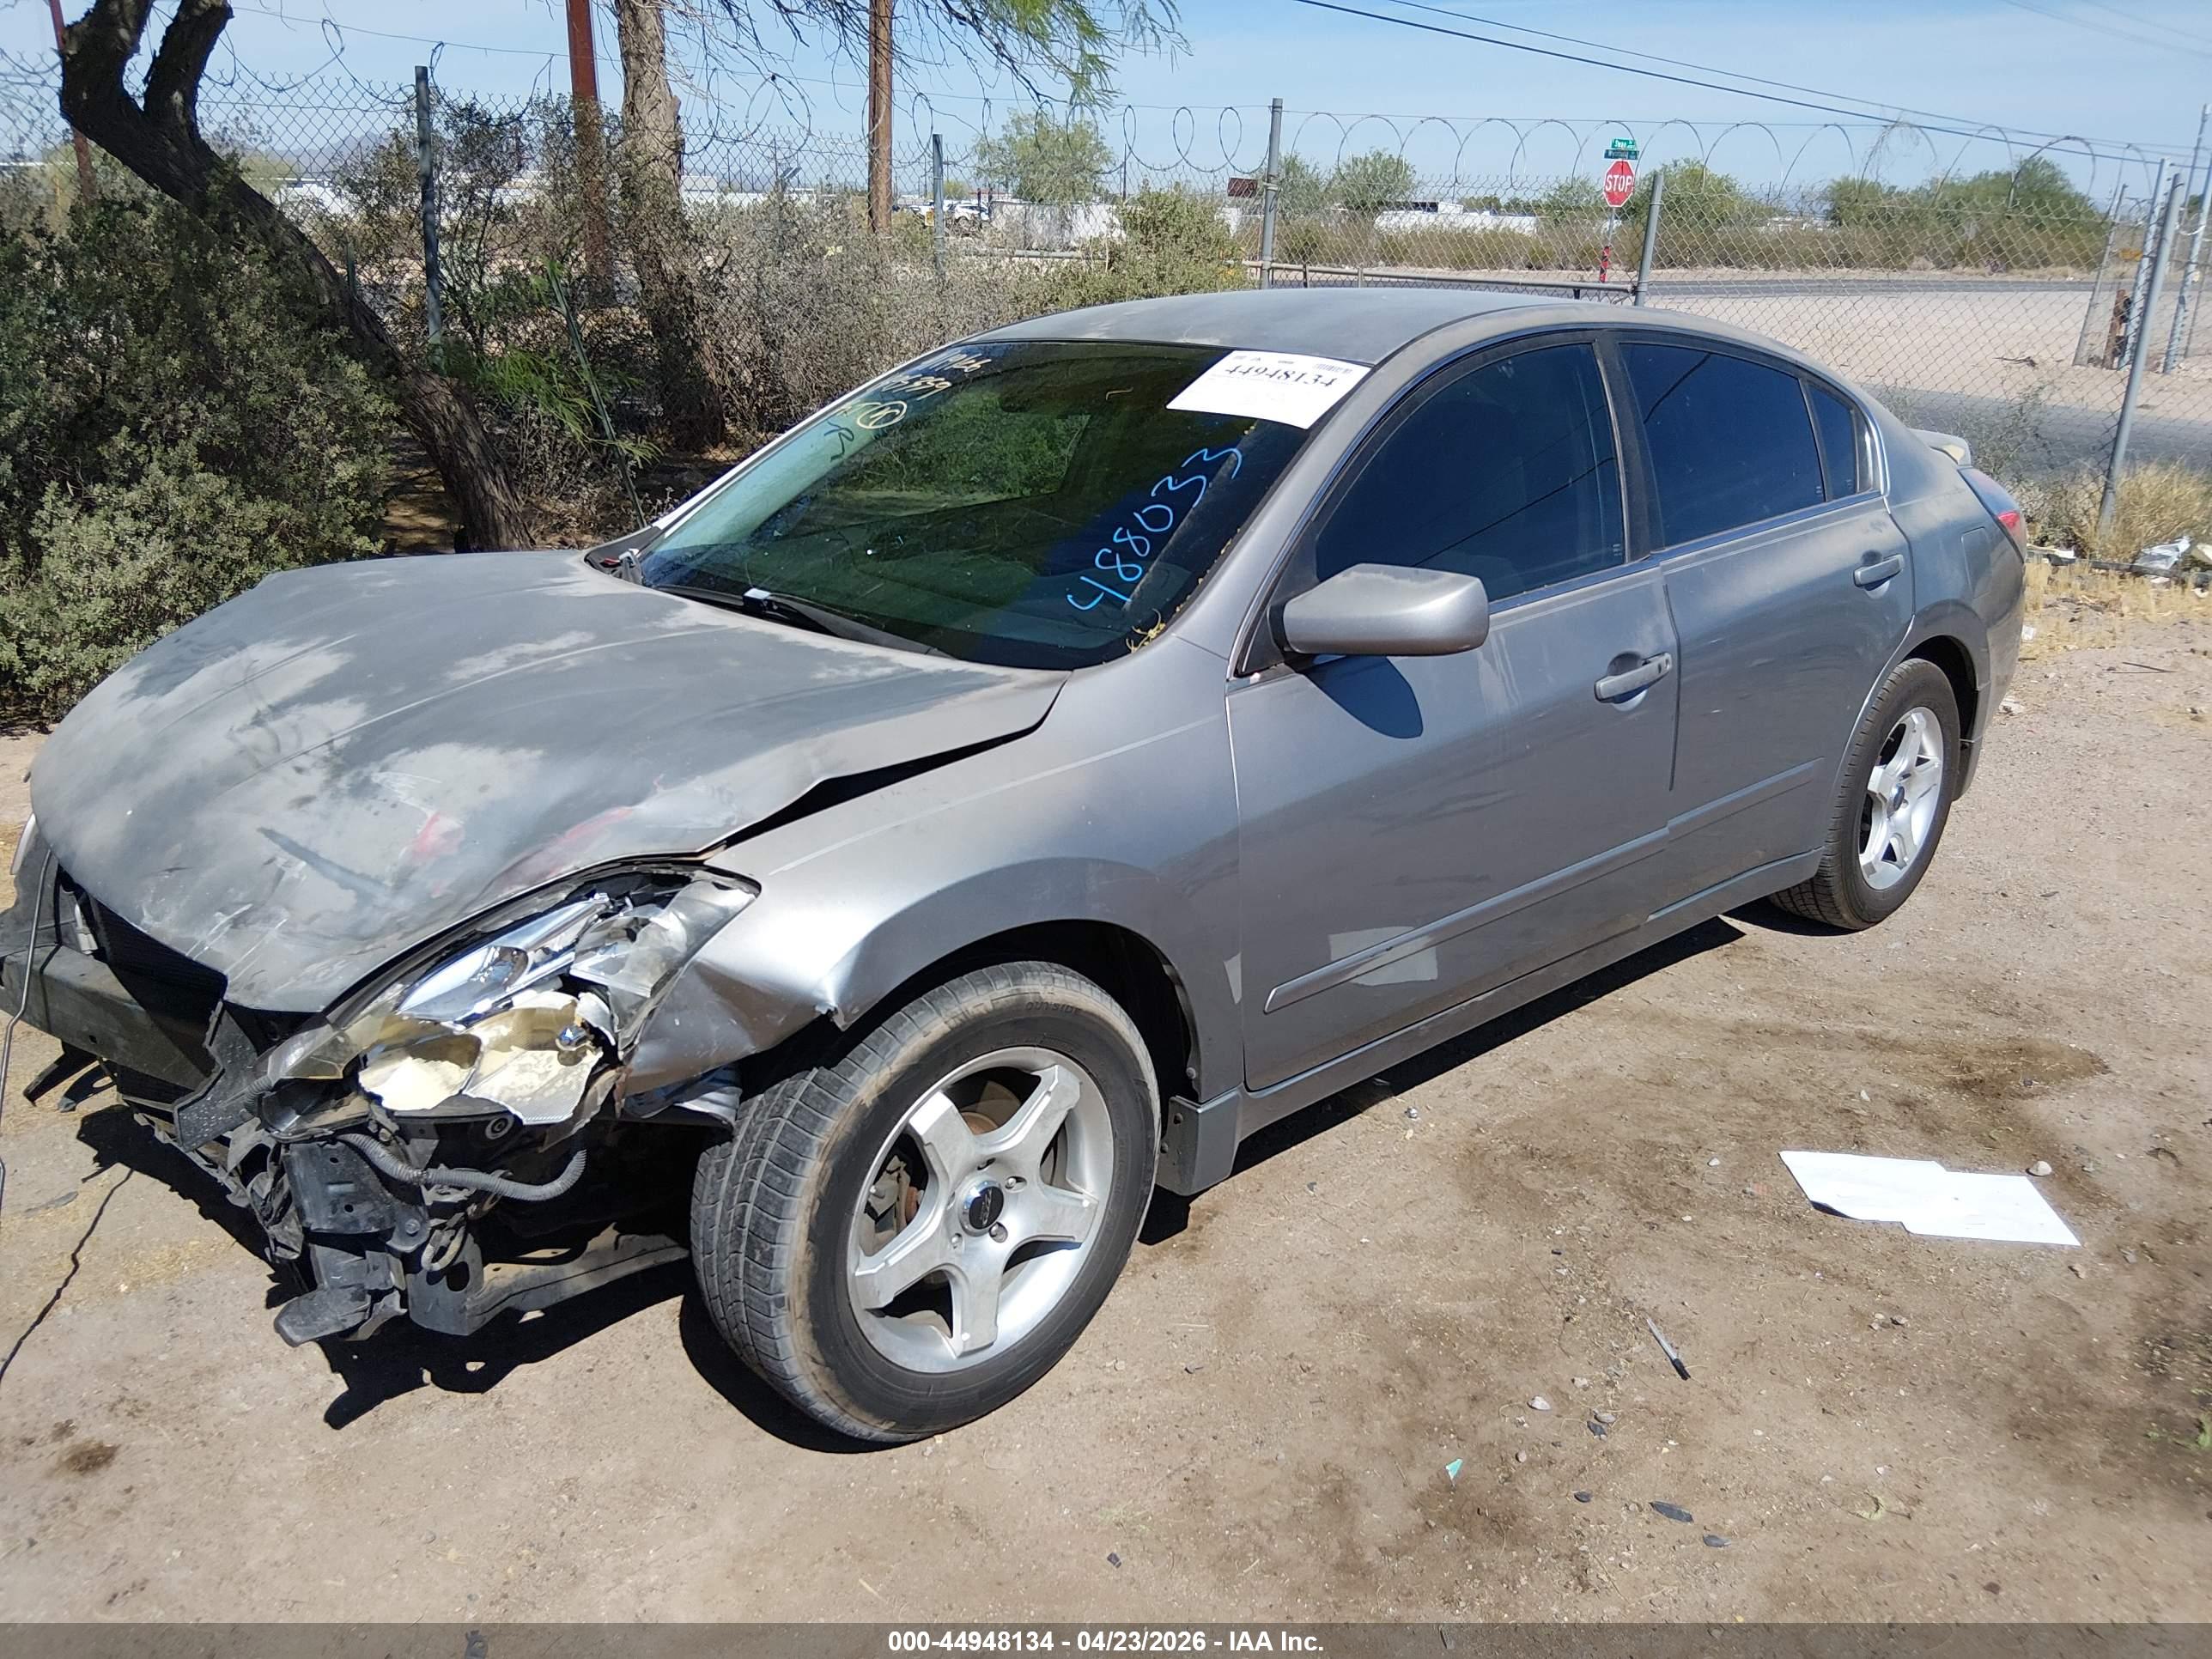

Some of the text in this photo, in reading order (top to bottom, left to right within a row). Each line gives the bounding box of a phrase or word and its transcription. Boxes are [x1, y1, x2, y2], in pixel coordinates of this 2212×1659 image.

[1606, 175, 1632, 191] STOP
[1225, 365, 1337, 386] 44948134
[1066, 447, 1243, 611] 488033
